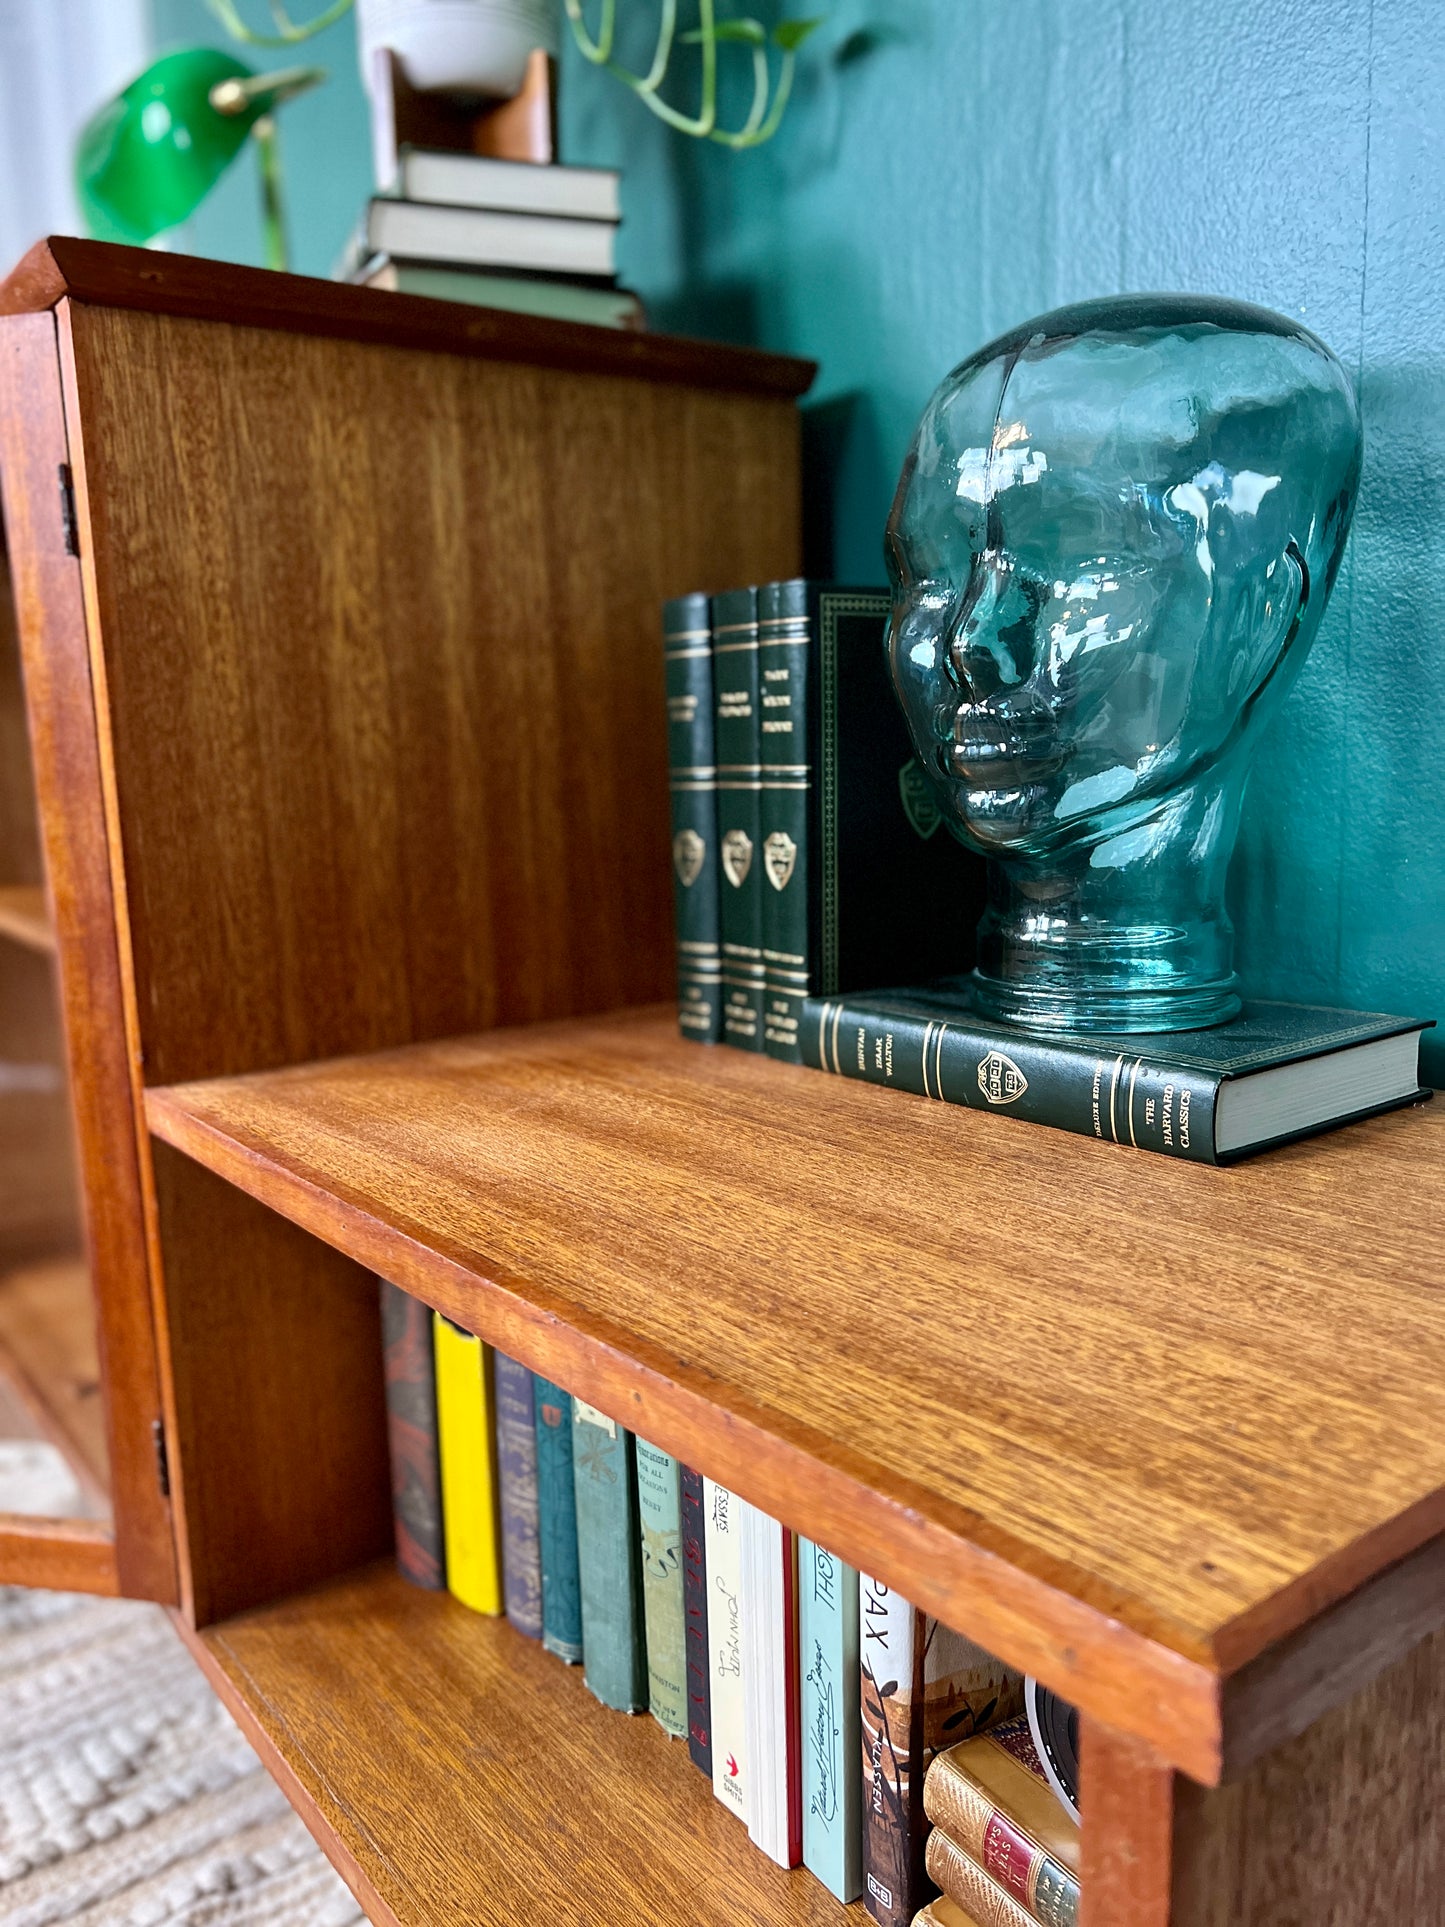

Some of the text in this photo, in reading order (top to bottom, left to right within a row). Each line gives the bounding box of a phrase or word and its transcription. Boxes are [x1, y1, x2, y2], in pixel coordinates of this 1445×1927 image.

[857, 1027, 866, 1071] BUNYAN
[885, 1033, 893, 1077] WALTON
[1092, 1102, 1103, 1137] DELUXE
[1145, 1097, 1155, 1125] THE
[1162, 1084, 1174, 1146] HARVARD
[1179, 1089, 1192, 1149] CLASSICS
[714, 1484, 730, 1534] ESSAYS
[684, 1535, 707, 1718] BEAUTY
[716, 1575, 741, 1678] JOHN MUIR
[810, 1698, 831, 1774] History
[723, 1782, 743, 1806] SMITH
[871, 1737, 883, 1814] KLASSEN
